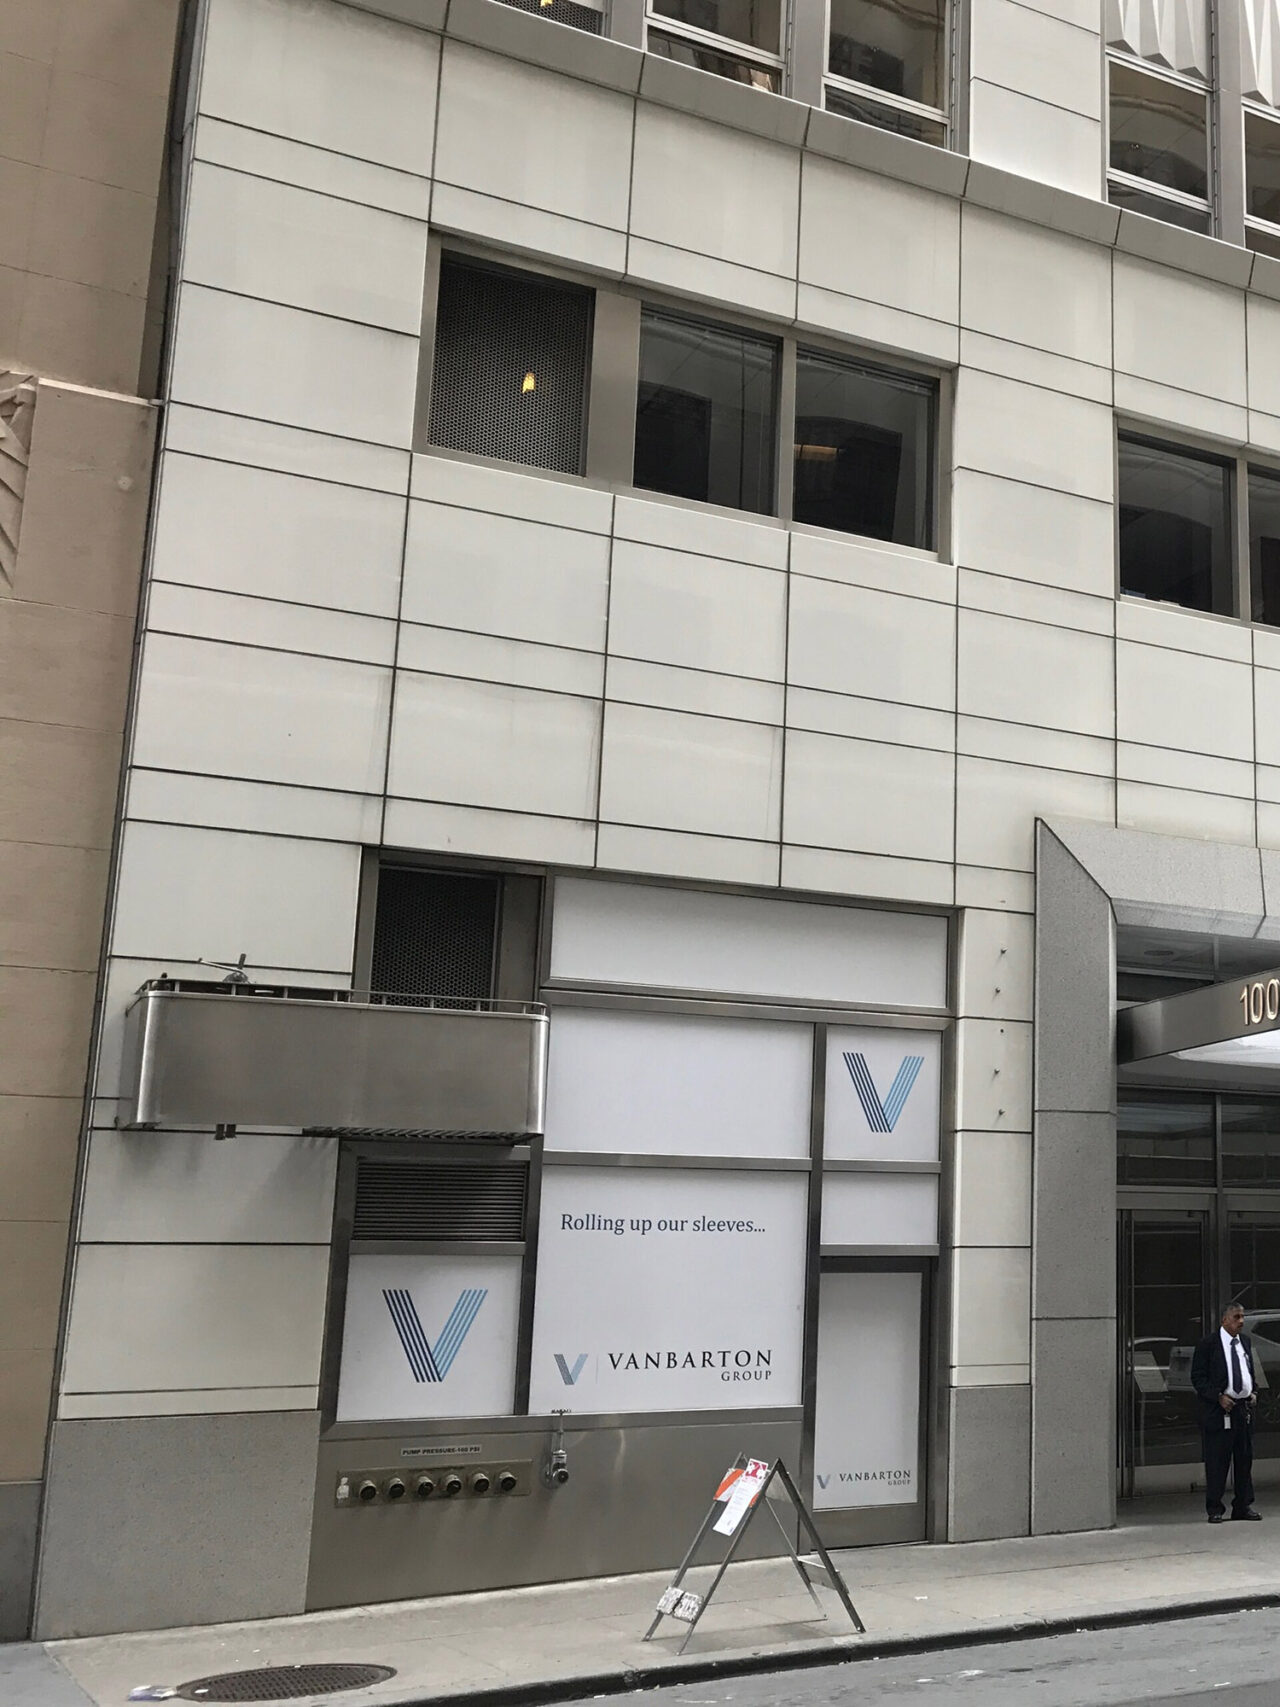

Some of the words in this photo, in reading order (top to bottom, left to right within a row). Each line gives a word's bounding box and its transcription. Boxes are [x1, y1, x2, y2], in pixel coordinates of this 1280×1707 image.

[1239, 978, 1280, 1025] 100
[561, 1213, 625, 1235] Rolling
[630, 1218, 653, 1235] up
[657, 1218, 688, 1232] our
[692, 1215, 766, 1233] sleeves...
[608, 1350, 773, 1370] VANBARTON
[720, 1370, 772, 1382] GROUP
[839, 1469, 911, 1482] VANBARTON
